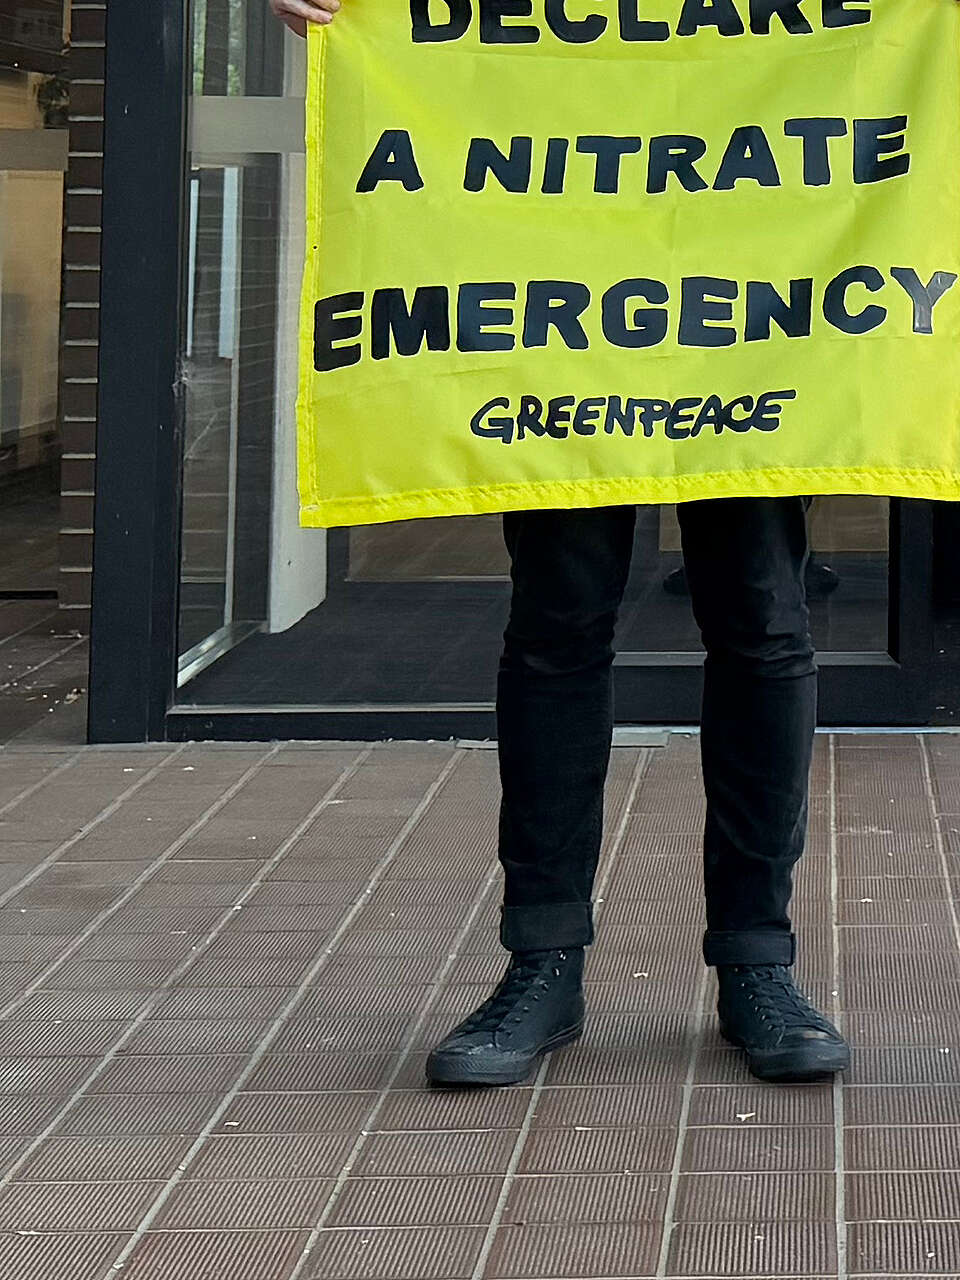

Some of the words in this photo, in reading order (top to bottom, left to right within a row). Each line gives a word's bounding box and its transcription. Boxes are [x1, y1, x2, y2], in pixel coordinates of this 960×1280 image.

[355, 129, 425, 193] A
[463, 115, 911, 194] NITRATE
[313, 265, 958, 372] EMERGENCY
[469, 389, 797, 445] GREENPEACE
